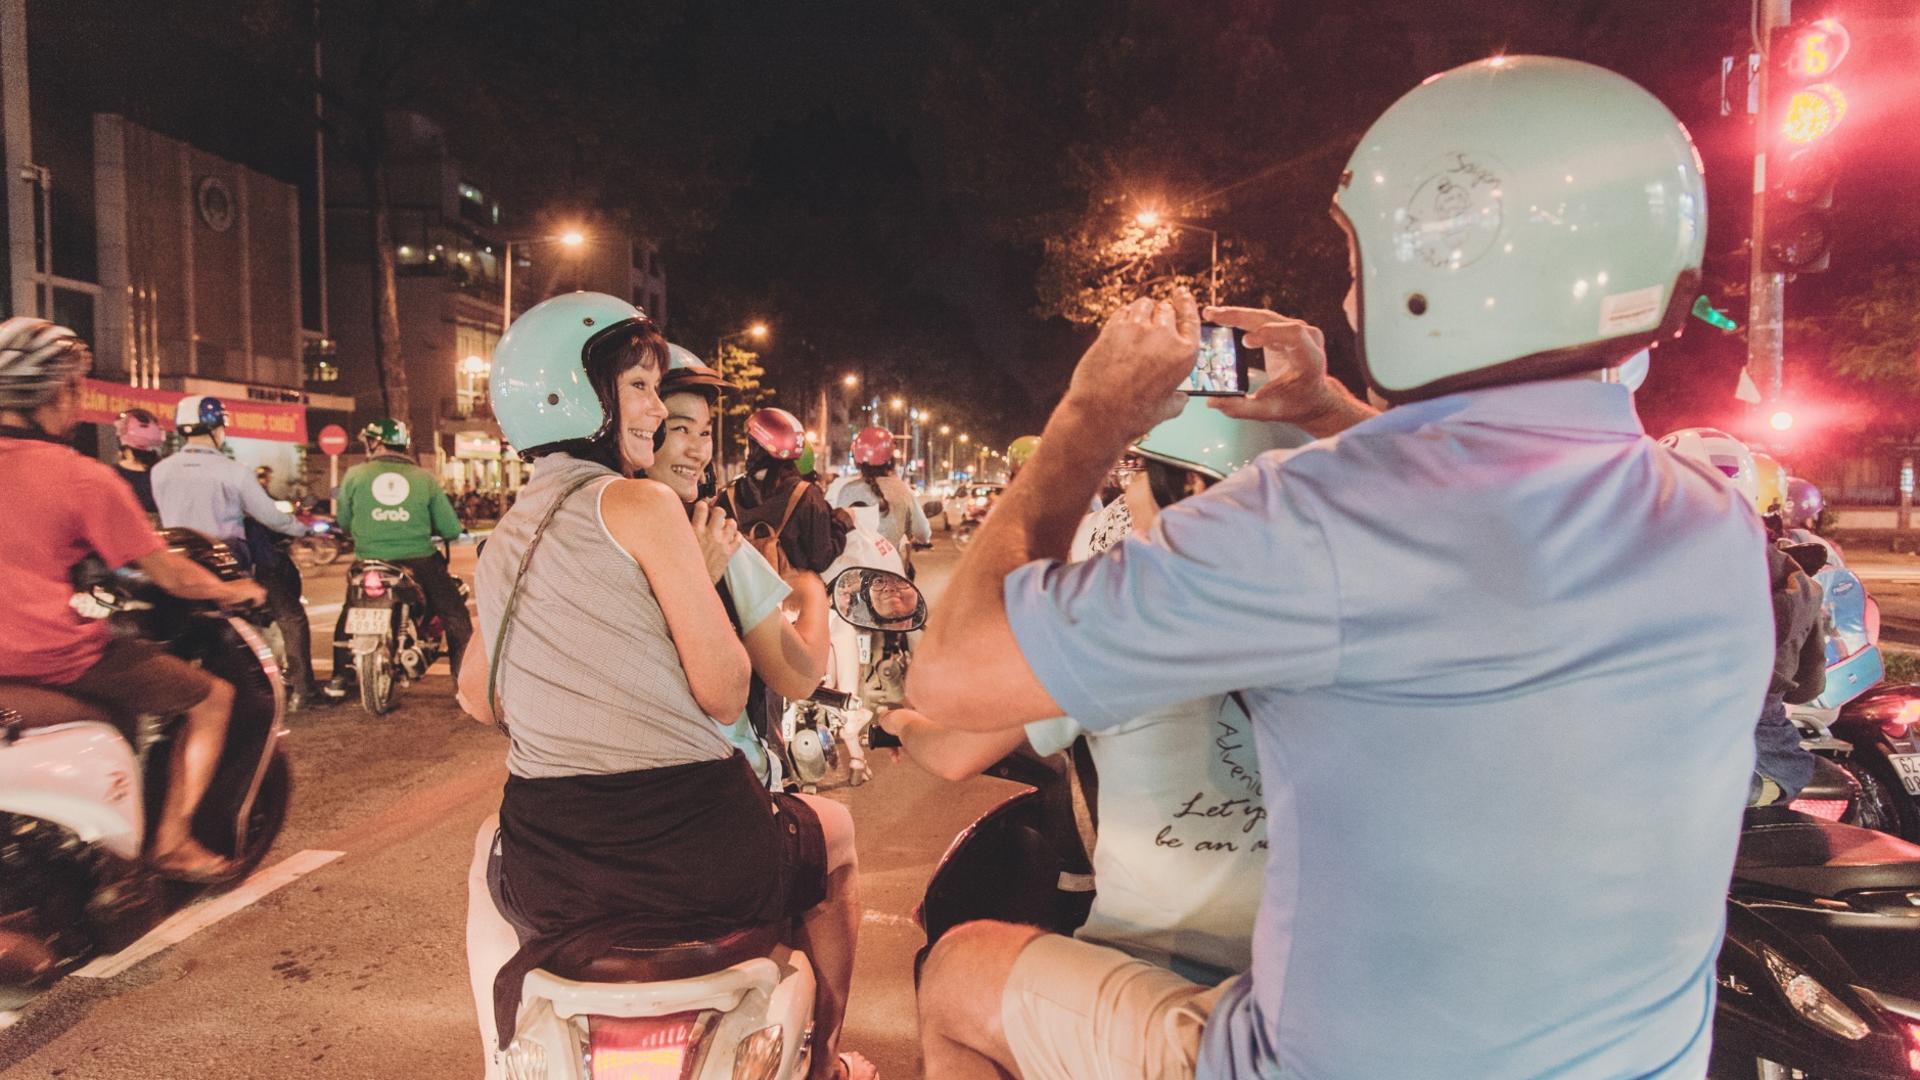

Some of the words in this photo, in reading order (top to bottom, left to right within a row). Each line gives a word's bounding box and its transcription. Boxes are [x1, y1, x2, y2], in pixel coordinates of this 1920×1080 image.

[371, 507, 410, 522] Grab
[1899, 756, 1920, 773] 62
[1173, 792, 1251, 818] Let
[1155, 825, 1185, 849] be
[1194, 840, 1239, 852] an
